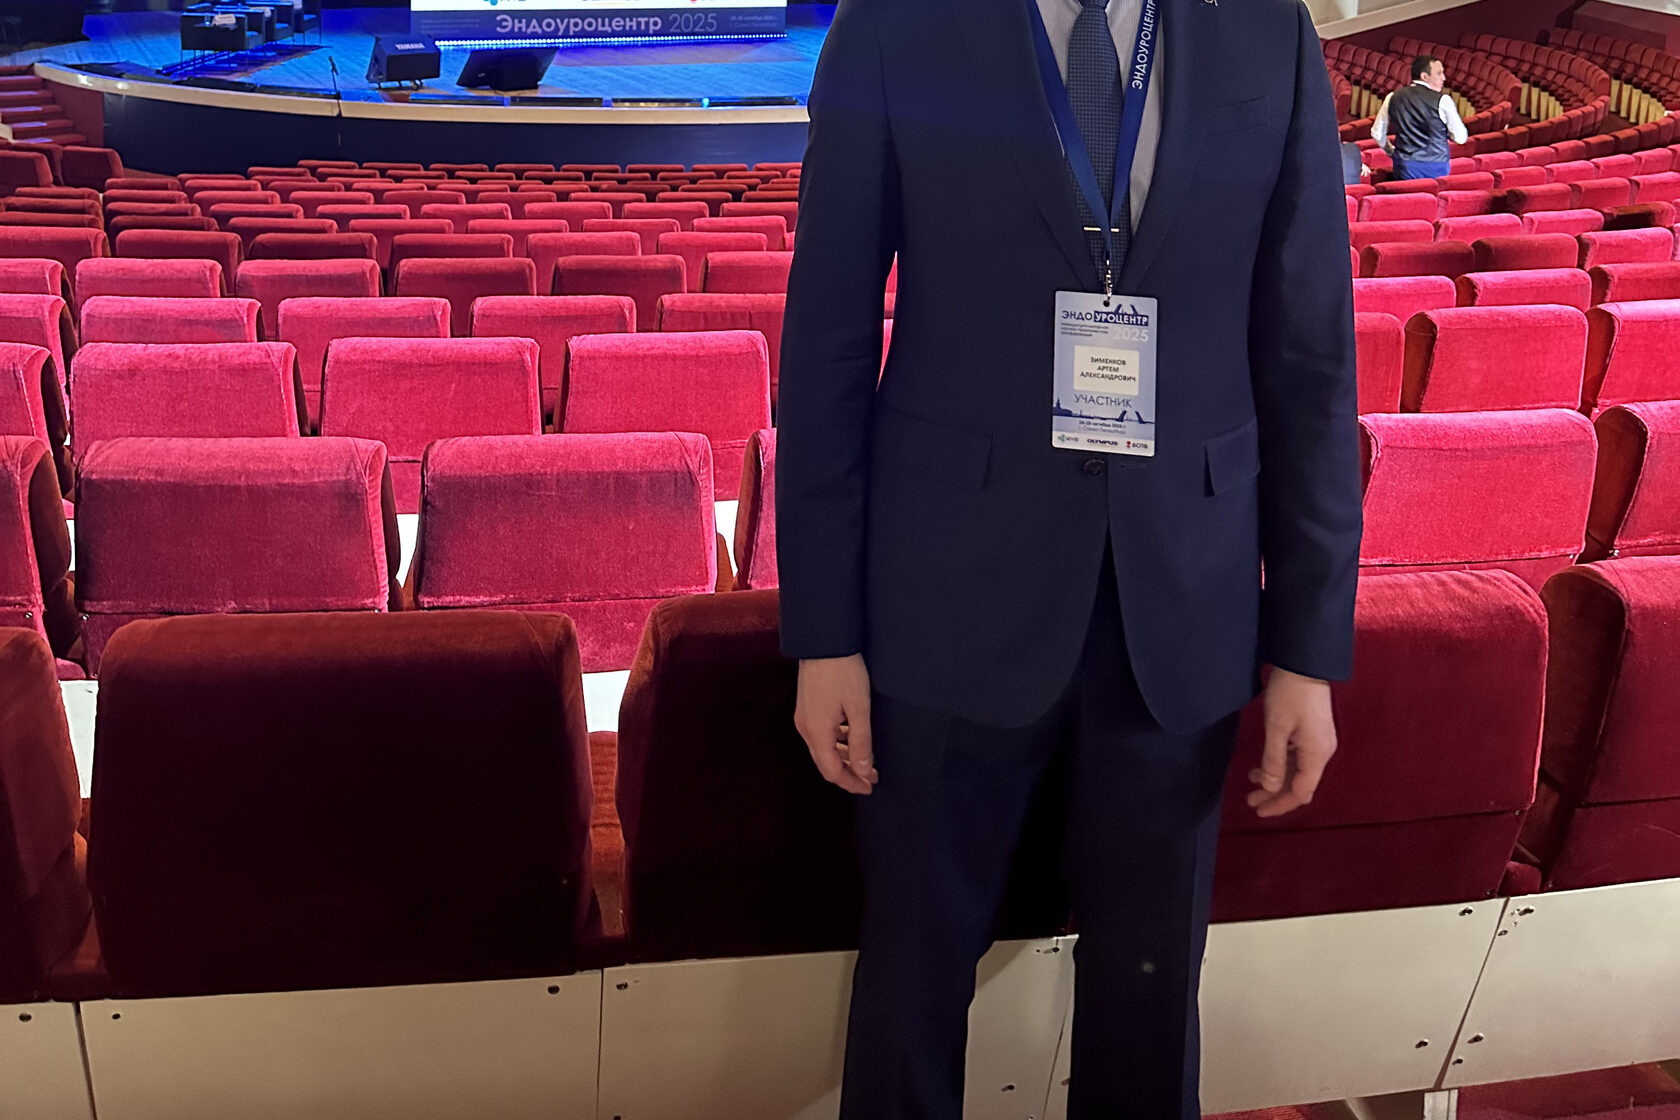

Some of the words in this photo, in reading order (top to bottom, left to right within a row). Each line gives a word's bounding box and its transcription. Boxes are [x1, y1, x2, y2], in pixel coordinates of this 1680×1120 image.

[495, 14, 662, 36] Эндоуроцентр
[669, 13, 717, 32] 2025
[1080, 371, 1136, 382] АЛЕКСАНДРОВИЧ
[1074, 393, 1132, 408] УЧАСТНИК
